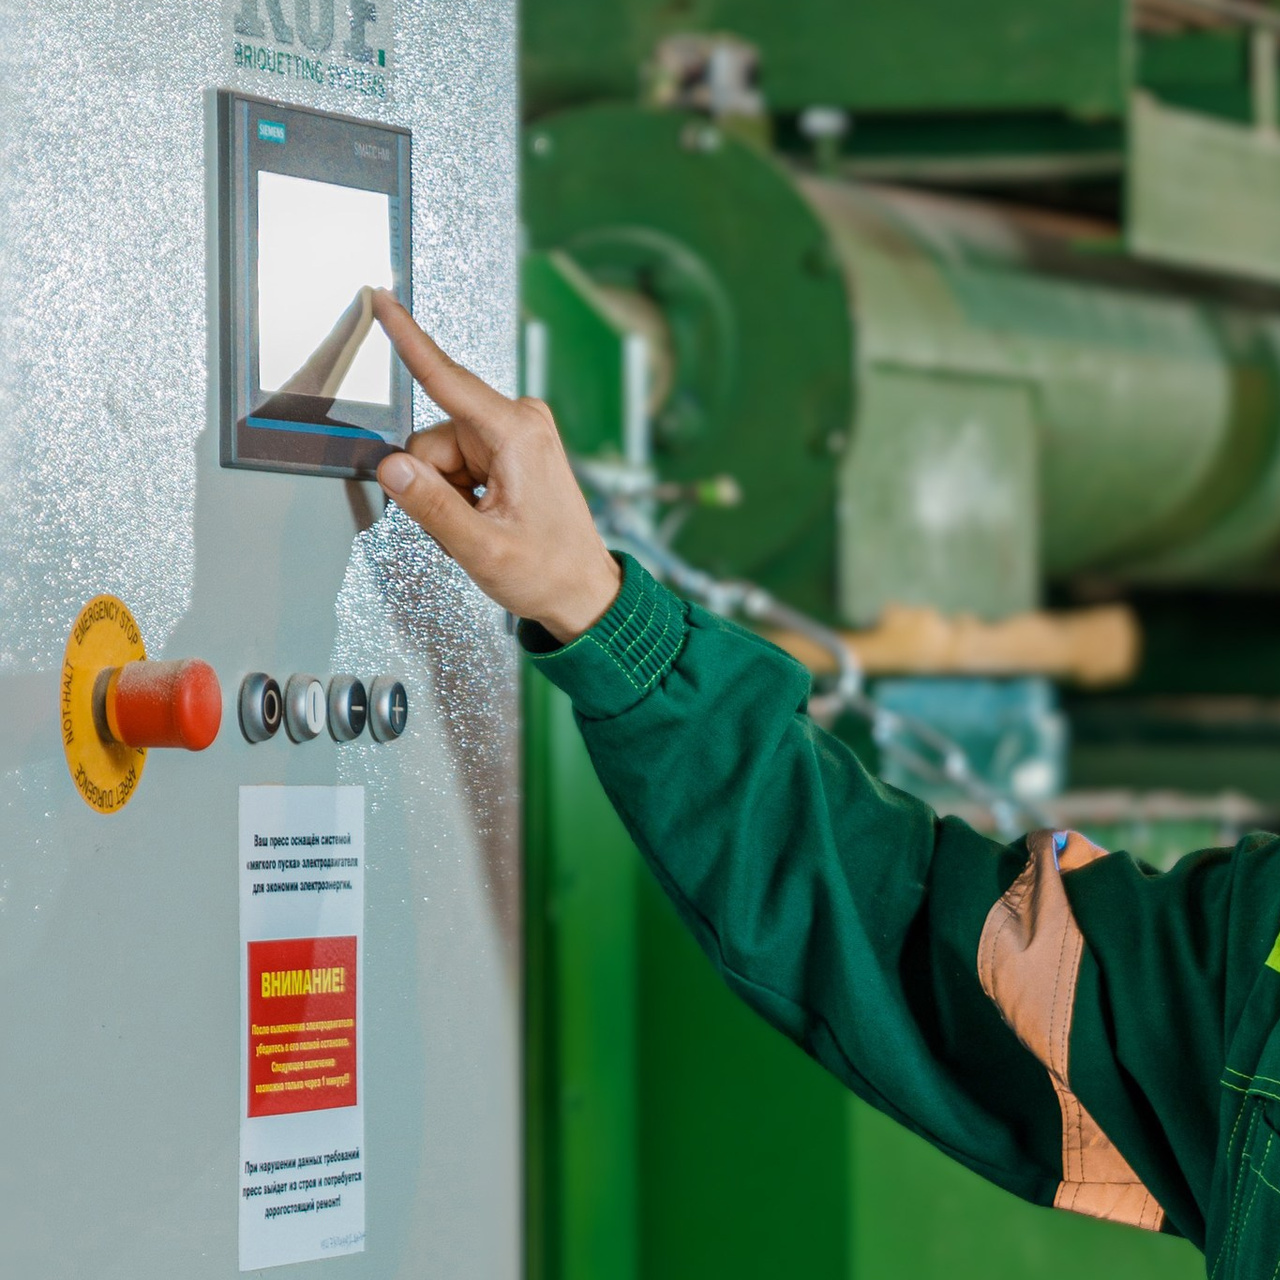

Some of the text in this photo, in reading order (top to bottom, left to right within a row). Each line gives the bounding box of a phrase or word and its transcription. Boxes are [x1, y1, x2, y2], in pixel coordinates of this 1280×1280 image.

[234, 41, 324, 84] BRIQUETTING
[259, 123, 285, 139] SIEMENS
[74, 600, 139, 646] EMERGENCY STOP
[62, 657, 75, 746] NOT-HALT
[253, 832, 352, 849] Ваш пресс оснащён системой
[246, 857, 359, 873] «мягкого пуска» электродвигателя
[252, 880, 353, 896] для экономии электроэнергии.
[261, 967, 345, 998] ВНИМАНИЕ!
[244, 1147, 360, 1176] При нарушении данных требований
[242, 1185, 262, 1200] пресс
[263, 1181, 288, 1196] выйдет
[289, 1182, 297, 1191] из
[298, 1178, 317, 1192] строя
[323, 1171, 362, 1188] потребуется
[264, 1194, 341, 1220] дорогостоящий ремонт!
